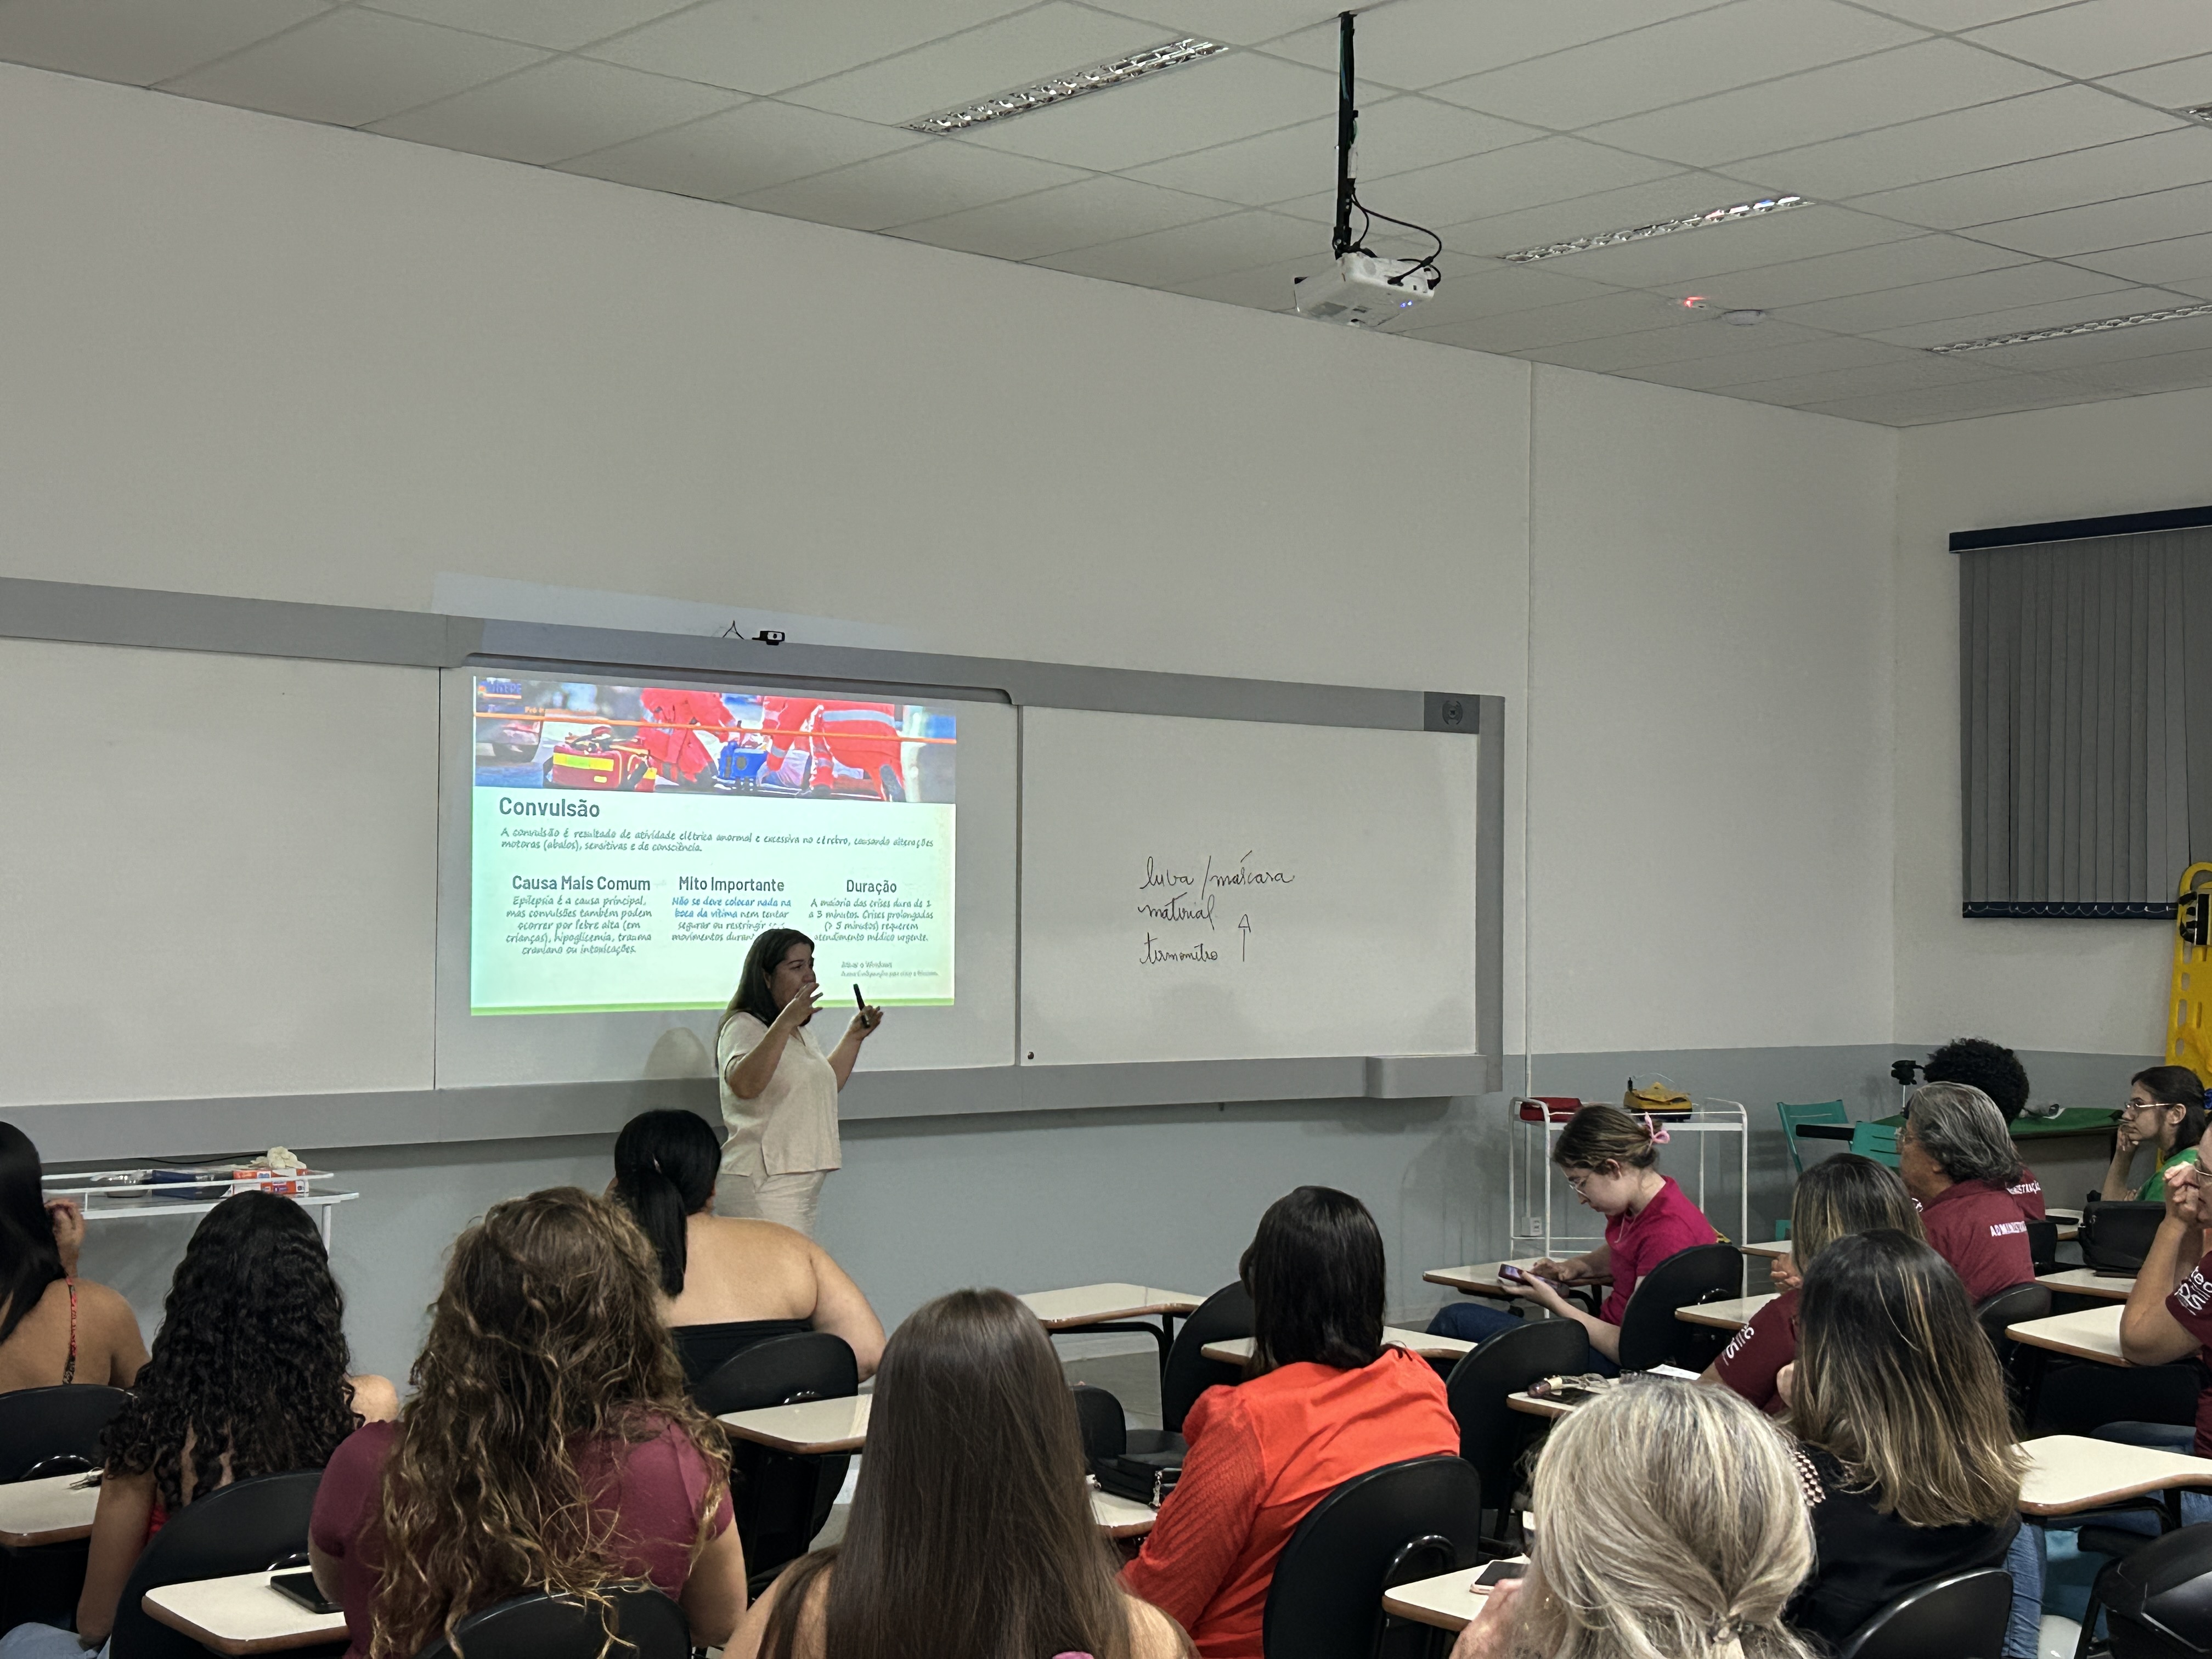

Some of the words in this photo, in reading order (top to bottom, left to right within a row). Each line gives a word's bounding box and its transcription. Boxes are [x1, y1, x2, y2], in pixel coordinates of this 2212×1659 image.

[499, 797, 600, 817] Convulsão
[501, 828, 509, 837] A
[512, 827, 560, 838] convulsão
[574, 829, 617, 839] resultado
[620, 829, 631, 839] de
[635, 830, 675, 840] atividade
[679, 831, 713, 841] elétrica
[716, 833, 752, 843] anormal
[764, 836, 799, 844] excessiva
[501, 840, 540, 849] motoras
[544, 839, 582, 851] (abalos),
[585, 840, 627, 851] sensitivas
[638, 841, 649, 851] de
[512, 875, 557, 889] Causa
[561, 875, 594, 890] Mais
[597, 876, 650, 890] Comum
[679, 876, 707, 890] Mito
[712, 877, 785, 893] Importante
[847, 879, 897, 895] Duração
[513, 895, 553, 907] Epilepsia
[557, 895, 562, 905] é
[672, 896, 689, 905] Não
[703, 896, 722, 906] deve
[725, 896, 755, 906] colocar
[758, 898, 778, 906] nada
[810, 899, 817, 907] A
[820, 898, 850, 907] maioria
[853, 898, 867, 907] das
[870, 899, 890, 907] crises
[894, 898, 911, 907] dura
[914, 899, 922, 907] de
[529, 908, 577, 918] convulsões
[580, 908, 618, 917] também
[620, 908, 652, 920] podem
[675, 908, 693, 917] boca
[697, 908, 707, 918] da
[711, 909, 737, 918] vítima
[862, 910, 885, 919] Crises
[887, 910, 934, 921] prolongadas
[1138, 892, 1215, 930] material
[556, 923, 572, 933] por
[575, 919, 599, 930] febre
[602, 920, 619, 929] alta
[623, 920, 640, 931] (em
[678, 922, 710, 932] segurar
[726, 920, 765, 932] restringir
[844, 921, 878, 931] minutos)
[882, 923, 918, 932] requerem
[672, 933, 723, 941] movimentos
[814, 932, 865, 941] atendimento
[867, 932, 895, 941] médico
[898, 934, 928, 944] urgente.
[522, 946, 563, 955] craniano
